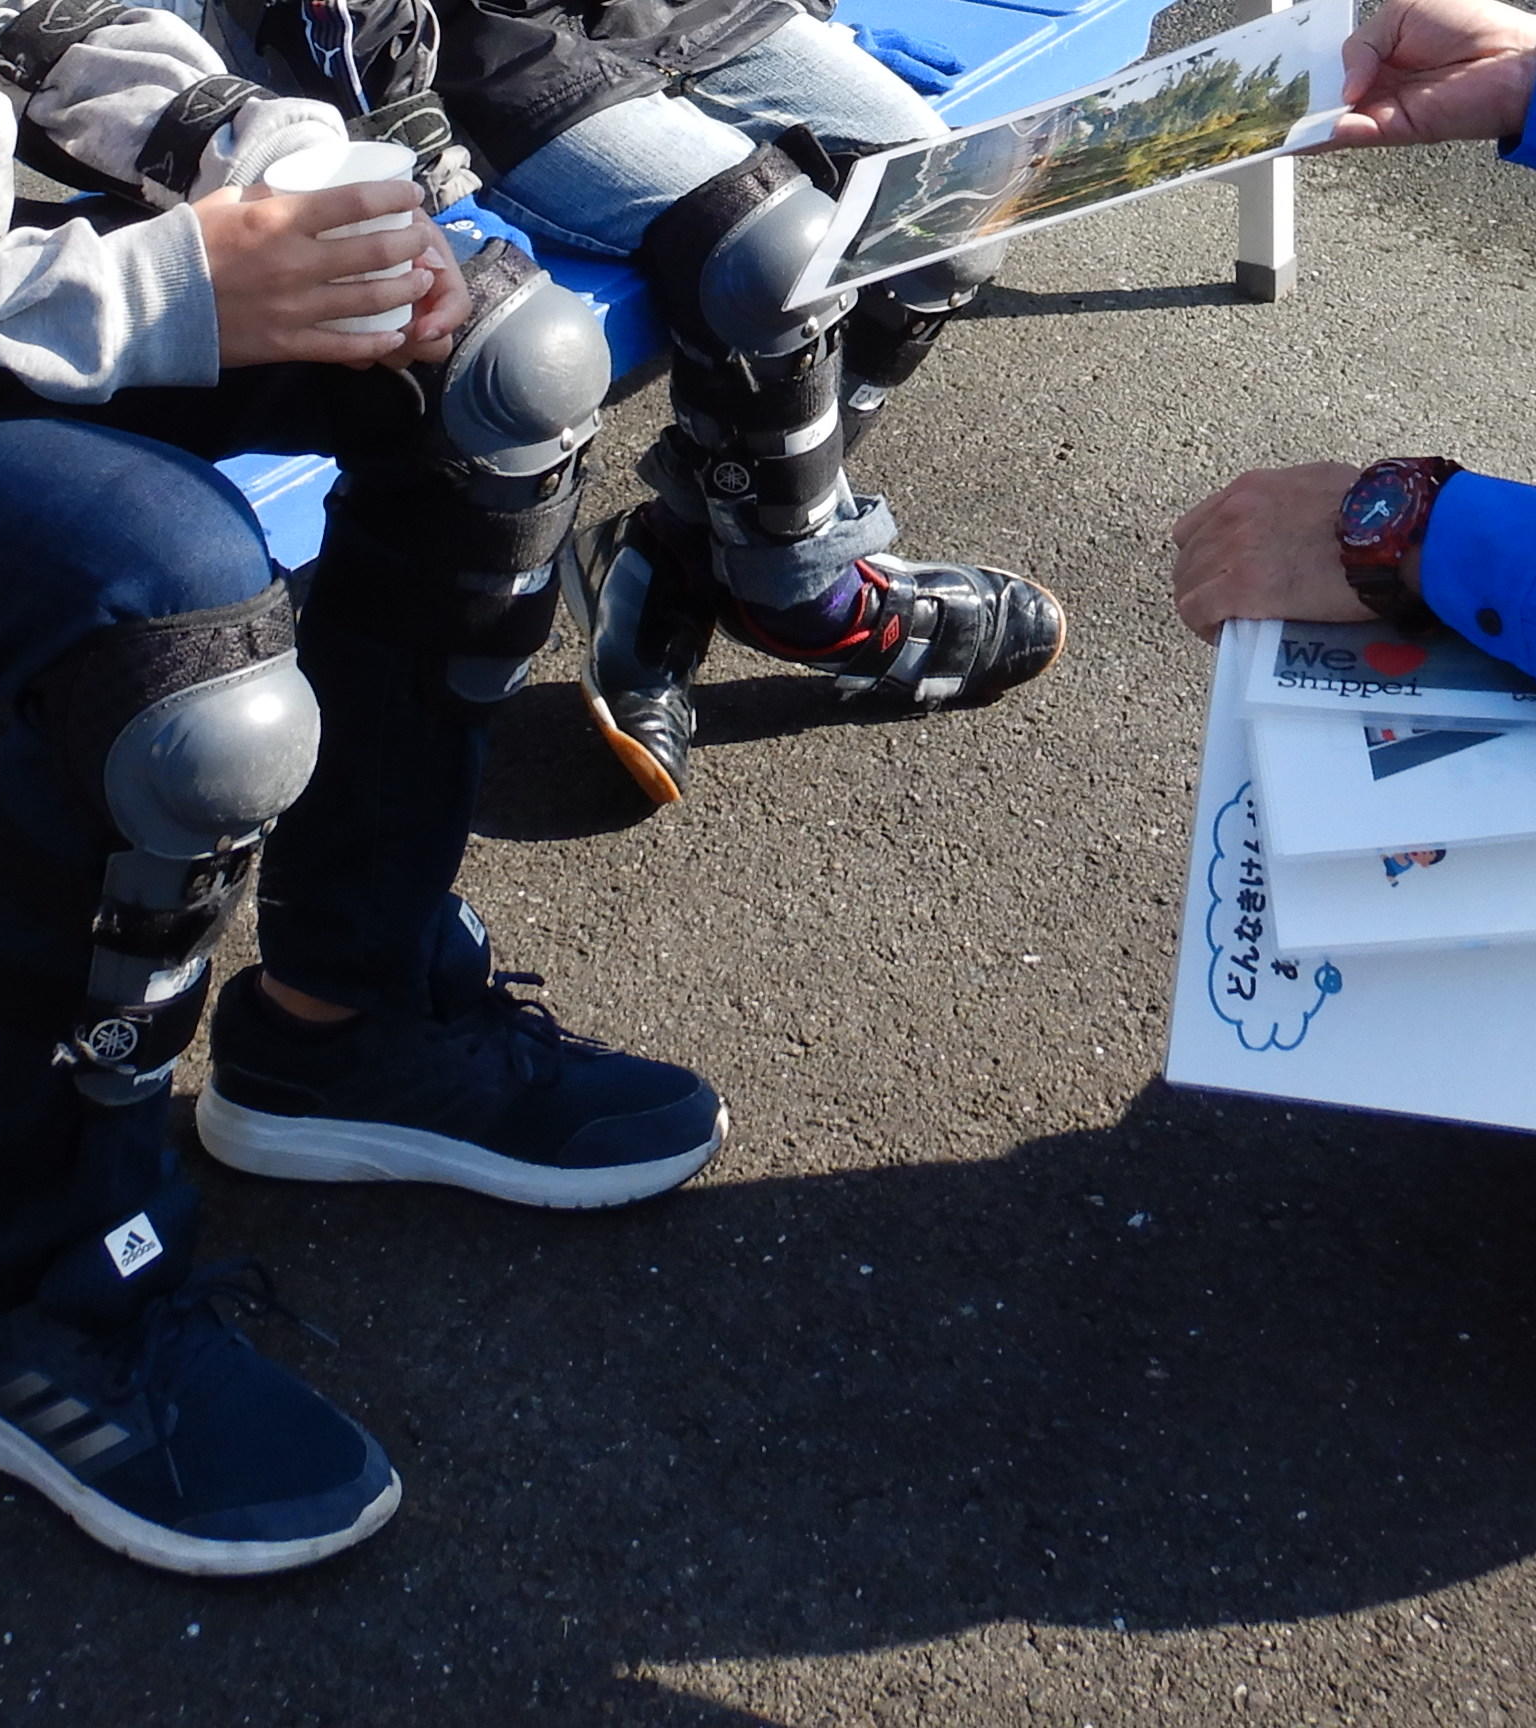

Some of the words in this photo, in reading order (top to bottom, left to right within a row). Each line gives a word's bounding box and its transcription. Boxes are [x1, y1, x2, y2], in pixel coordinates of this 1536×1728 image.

[1280, 639, 1357, 671] We
[1277, 671, 1422, 699] Shippei
[120, 1239, 156, 1268] adidas
